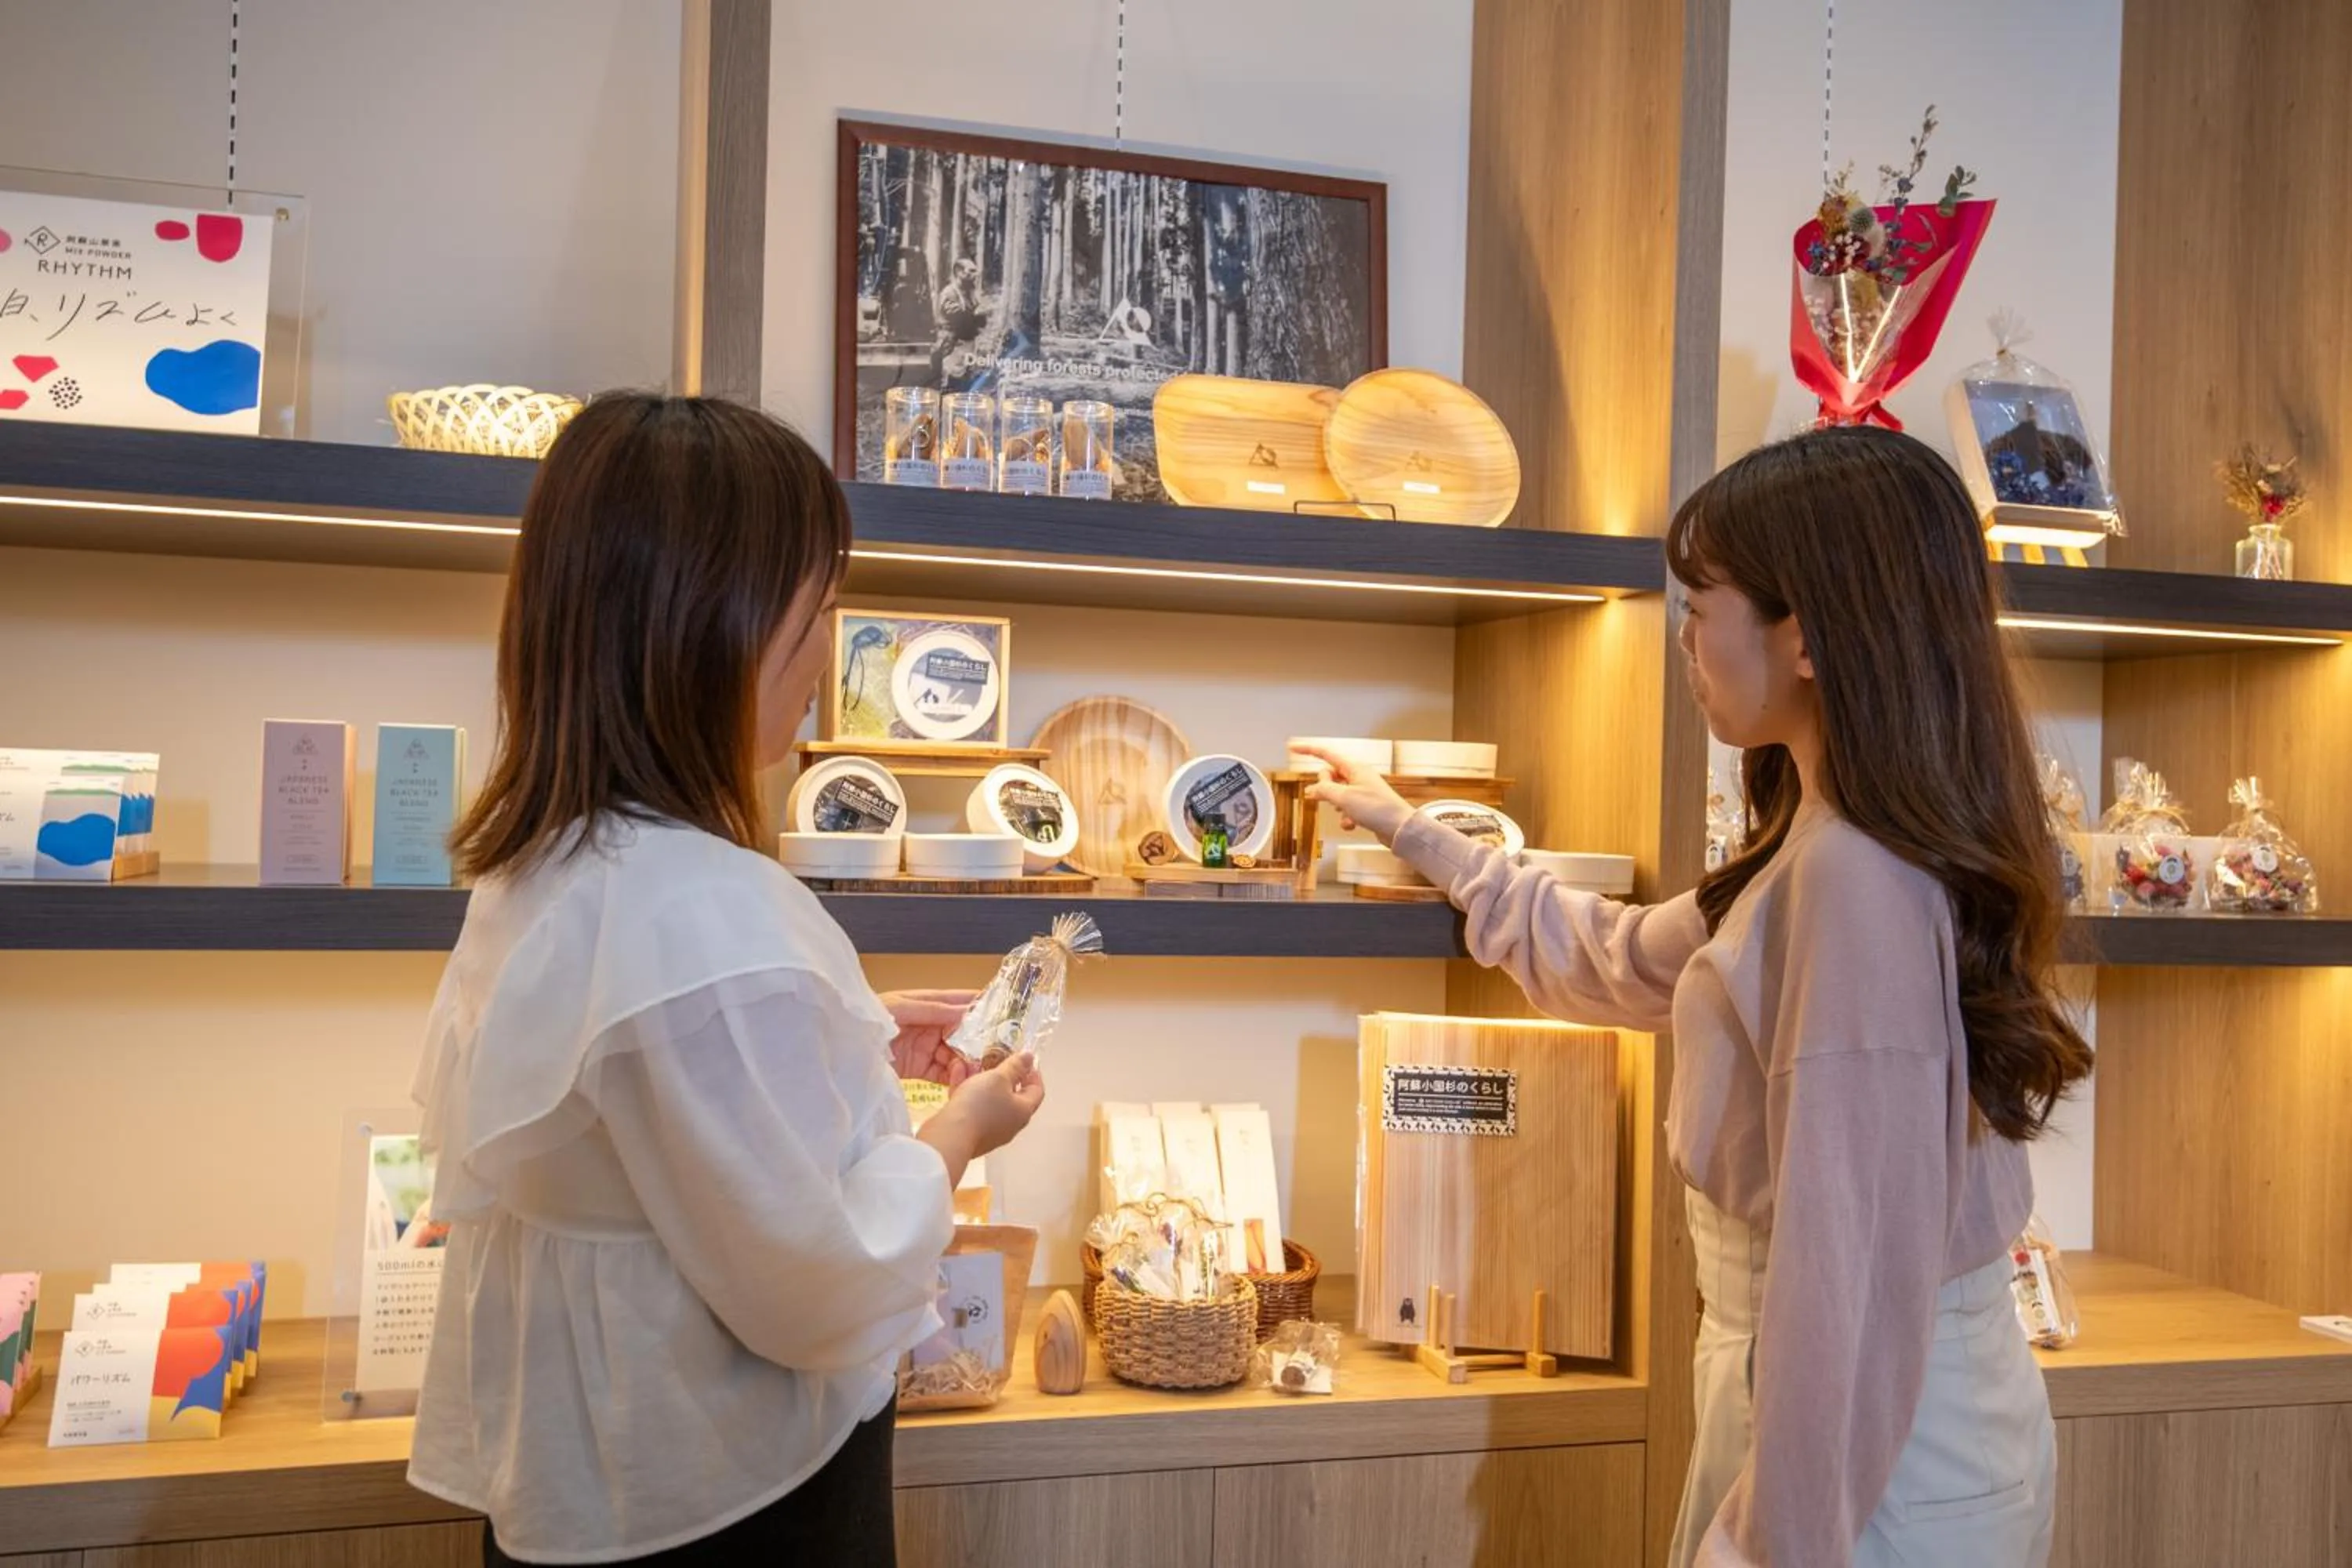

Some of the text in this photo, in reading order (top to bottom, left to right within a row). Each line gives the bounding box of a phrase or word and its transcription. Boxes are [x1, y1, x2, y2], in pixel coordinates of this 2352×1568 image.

[38, 260, 132, 280] RHYTHM
[964, 353, 1044, 374] Delivering
[1047, 357, 1101, 376] forests
[1398, 1078, 1503, 1094] 阿蘇小国杉のくらし
